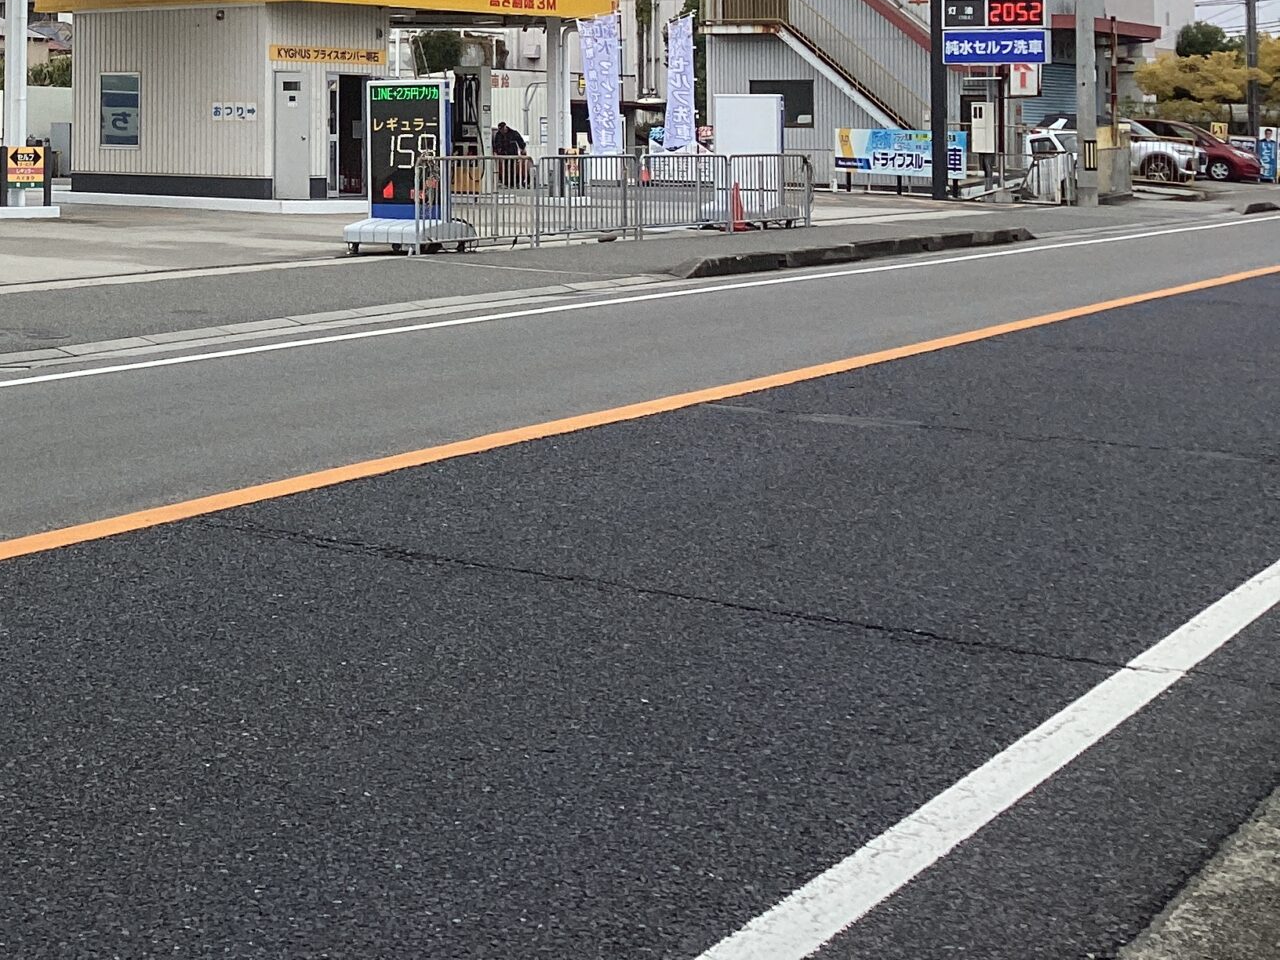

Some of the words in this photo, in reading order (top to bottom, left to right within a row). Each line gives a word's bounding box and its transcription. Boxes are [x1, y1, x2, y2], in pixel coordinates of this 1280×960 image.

[989, 2, 1042, 23] 2052
[277, 47, 311, 60] KYGNUS
[945, 39, 1043, 55] 純水セルフ洗車
[212, 106, 245, 119] おつり
[372, 116, 438, 132] レギュラー
[872, 147, 963, 173] ドライブスルー車
